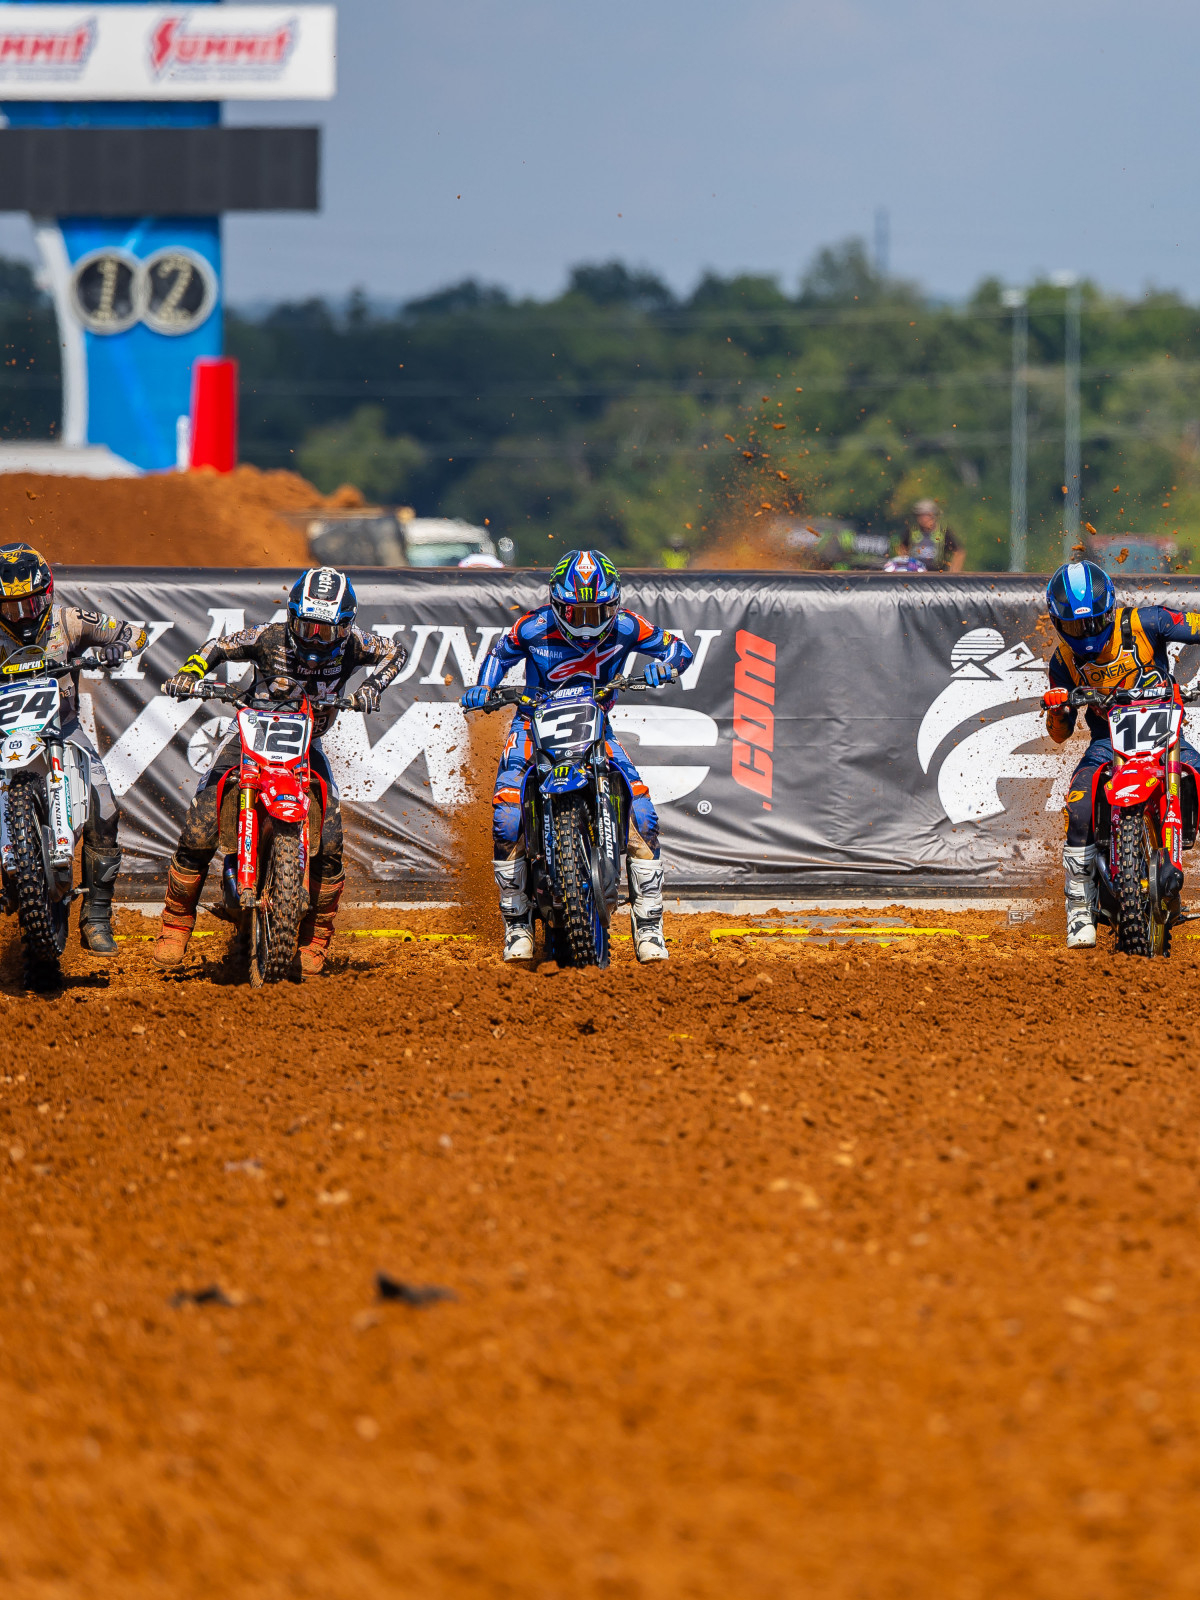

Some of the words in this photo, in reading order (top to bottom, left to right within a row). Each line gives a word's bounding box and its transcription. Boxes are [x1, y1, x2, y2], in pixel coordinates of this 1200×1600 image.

[536, 646, 563, 659] YAMAHA
[0, 691, 56, 725] 24
[253, 720, 303, 755] 12
[541, 704, 595, 748] 3
[1116, 712, 1170, 752] 14
[1115, 792, 1140, 800] HONDA
[603, 808, 614, 859] DUNLOP
